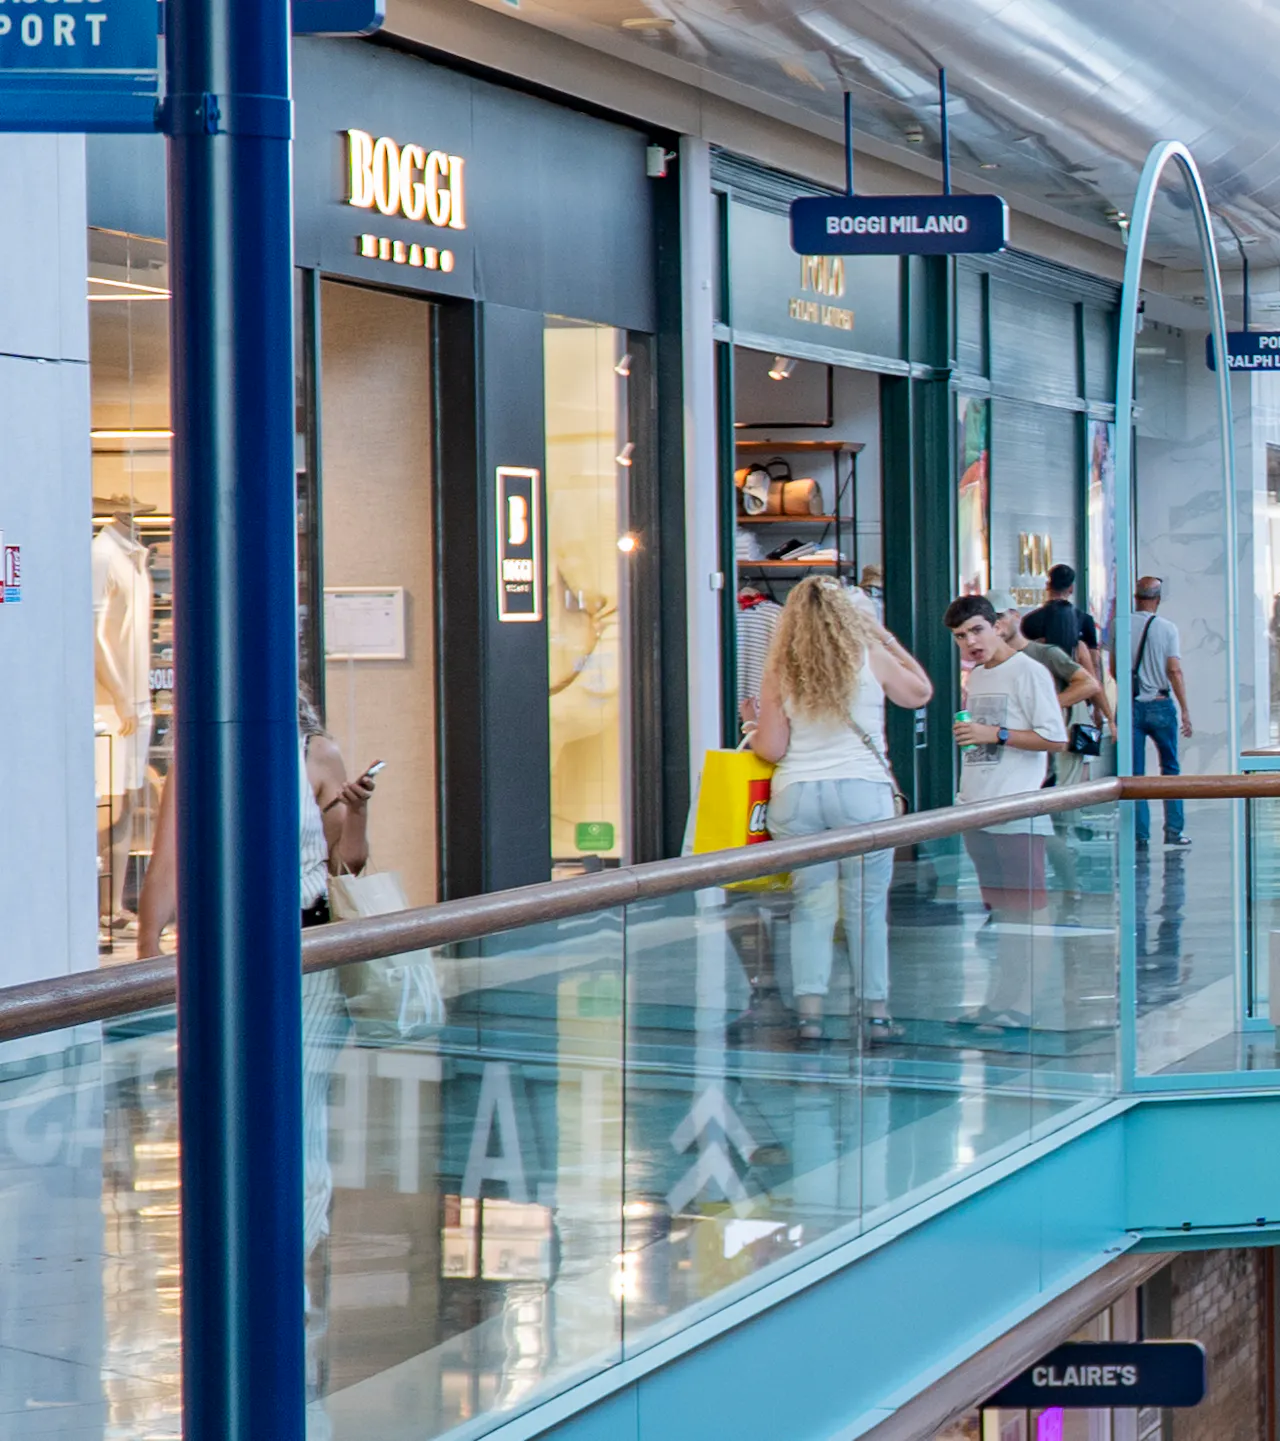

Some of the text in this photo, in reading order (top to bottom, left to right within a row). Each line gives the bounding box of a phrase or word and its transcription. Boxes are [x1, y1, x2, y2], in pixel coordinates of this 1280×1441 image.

[347, 128, 466, 230] BOGGI
[826, 214, 969, 235] BOGGI MILANO
[360, 233, 455, 274] MILANO
[1225, 354, 1273, 368] RALPH
[507, 495, 529, 545] B
[1032, 1364, 1138, 1387] CLAIRE'S
